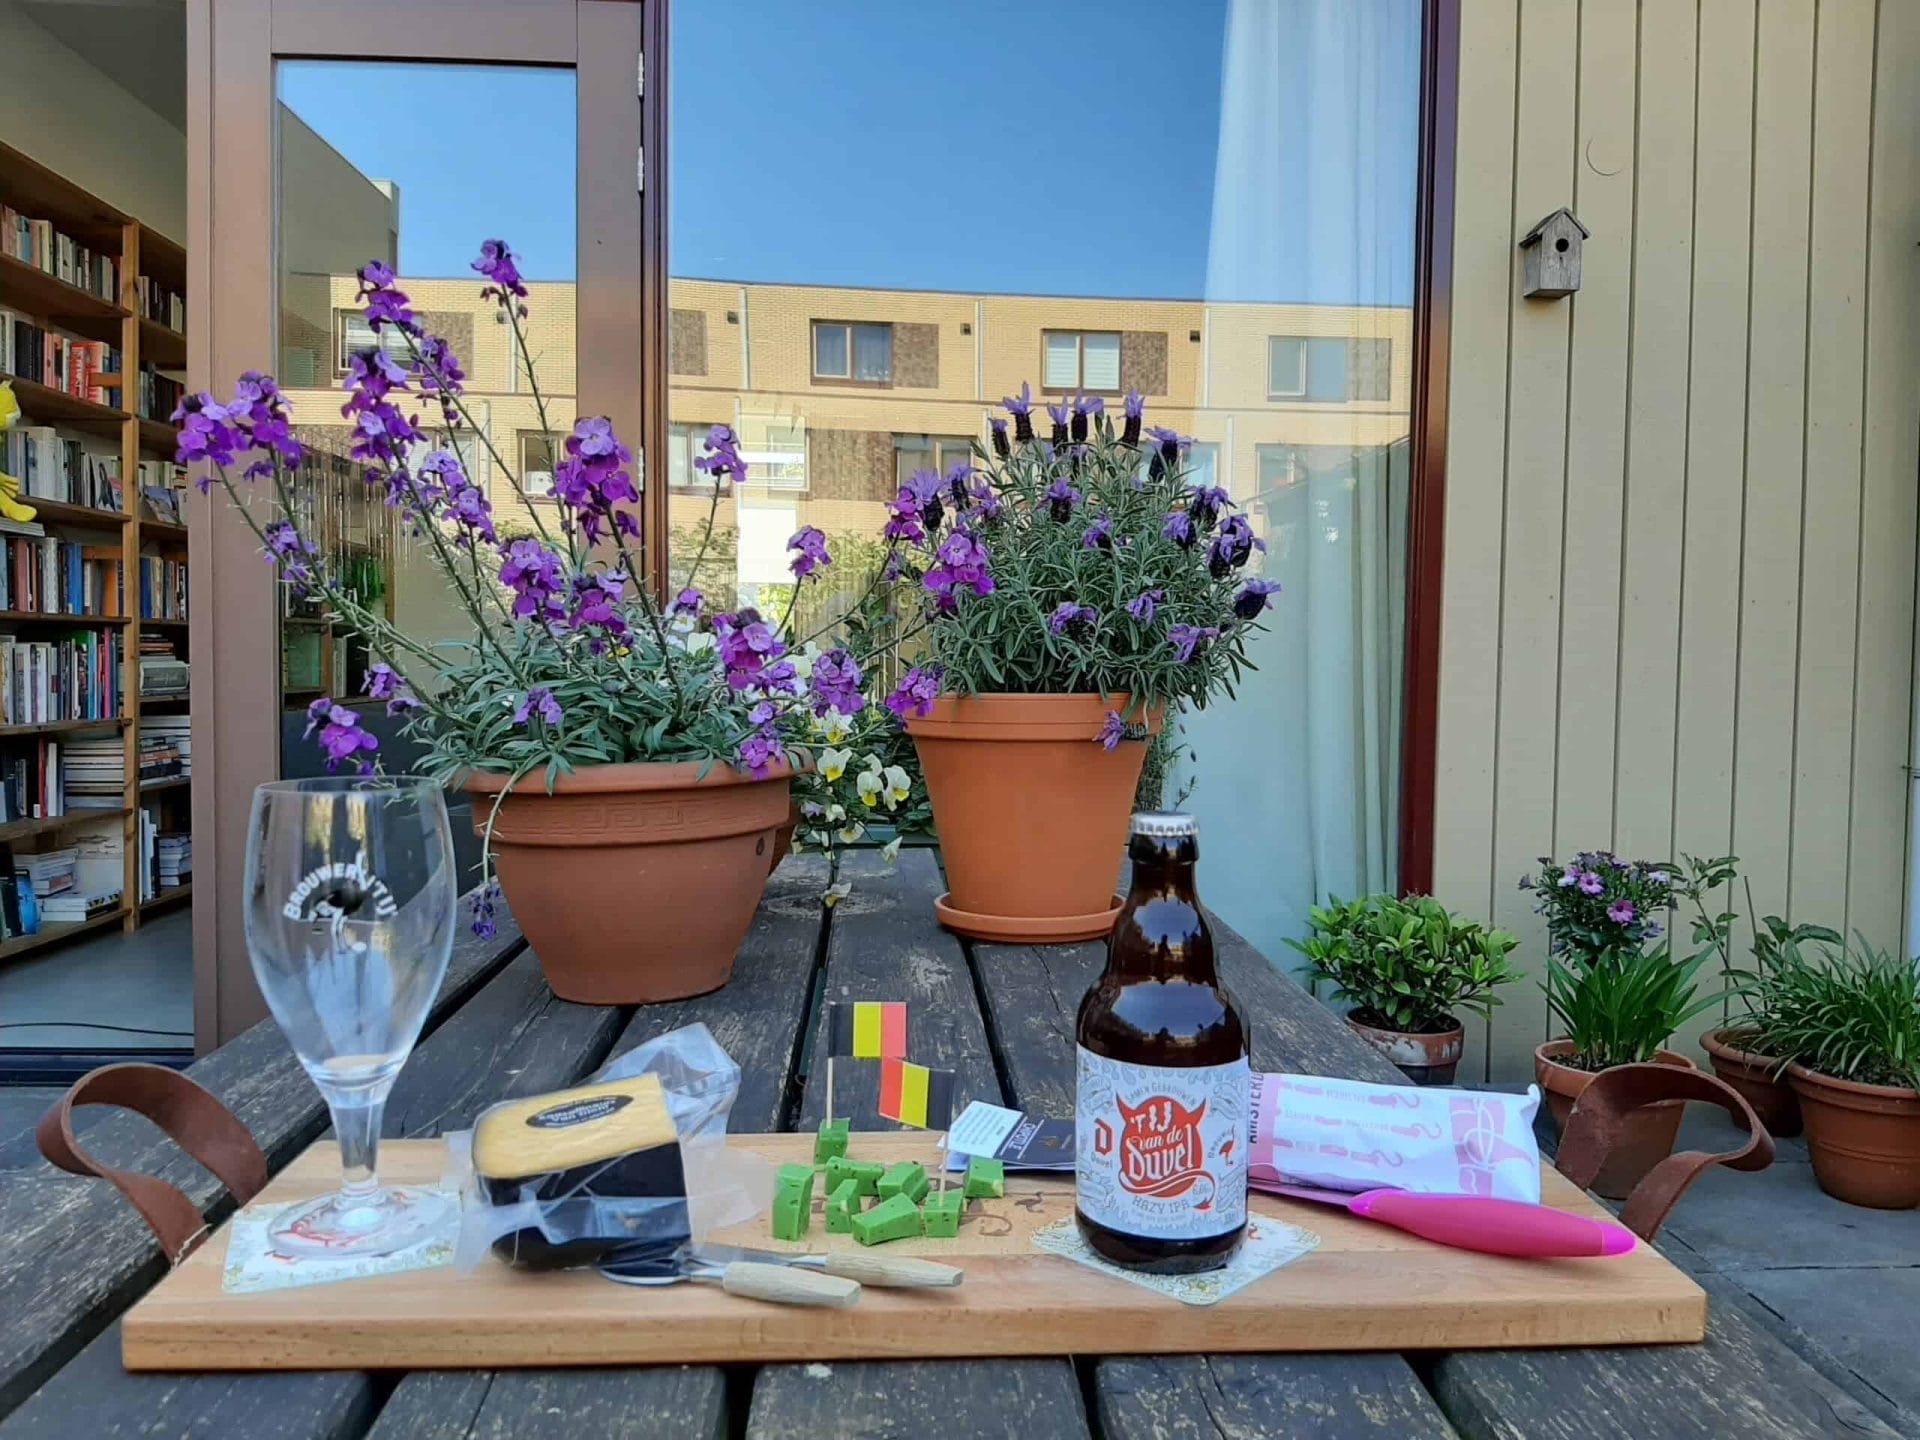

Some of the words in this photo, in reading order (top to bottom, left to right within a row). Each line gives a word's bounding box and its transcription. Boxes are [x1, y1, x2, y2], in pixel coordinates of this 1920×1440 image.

[1134, 1136, 1164, 1150] van
[1166, 1125, 1184, 1145] de
[1126, 1123, 1194, 1181] Duvel
[1131, 1195, 1166, 1215] HAZY
[1168, 1199, 1191, 1214] IPA
